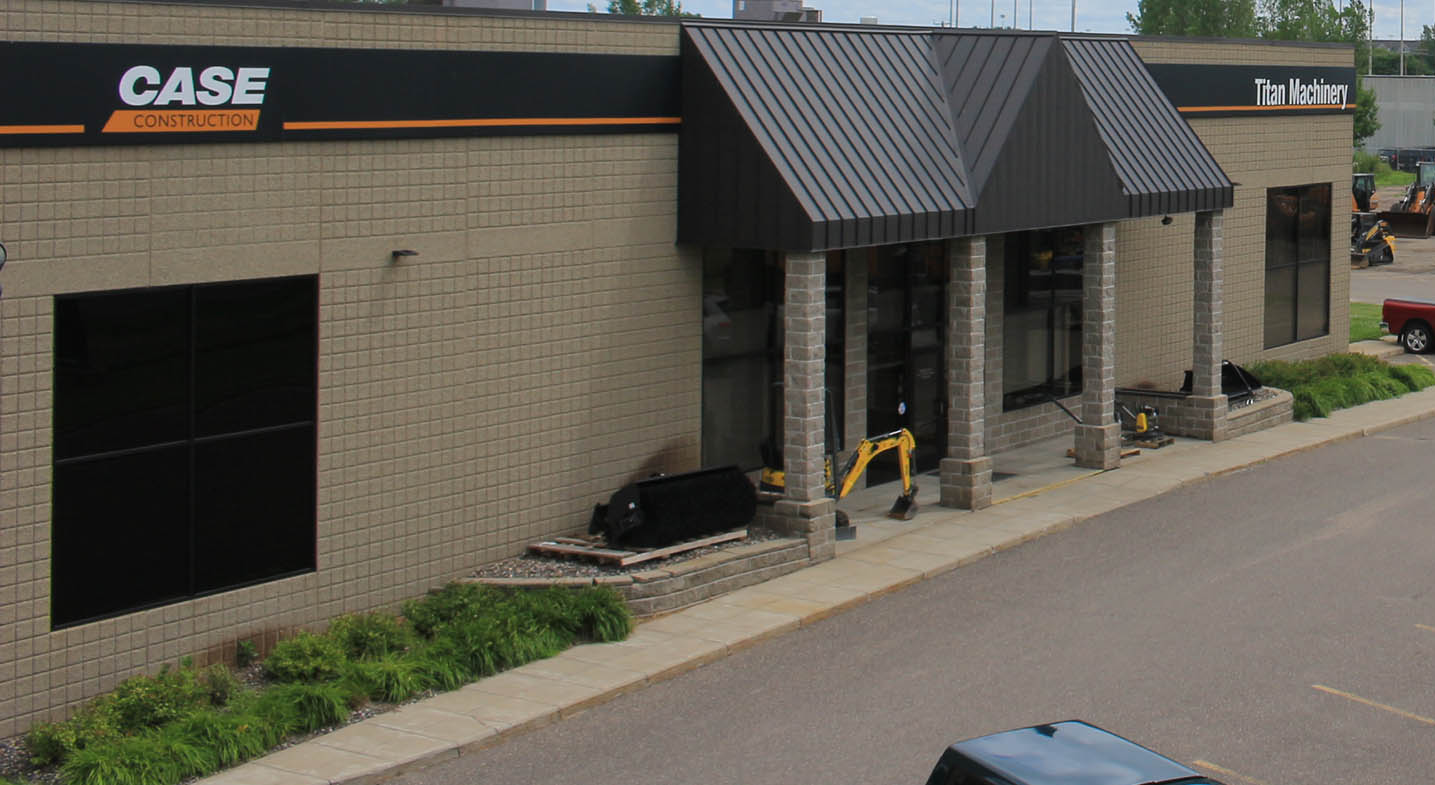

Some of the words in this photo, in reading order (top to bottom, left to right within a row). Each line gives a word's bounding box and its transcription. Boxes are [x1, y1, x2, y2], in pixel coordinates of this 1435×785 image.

[119, 65, 270, 106] CASE
[1255, 78, 1286, 106] Titan
[1289, 78, 1348, 110] Machinery
[134, 113, 254, 128] CONSTRUCTION
